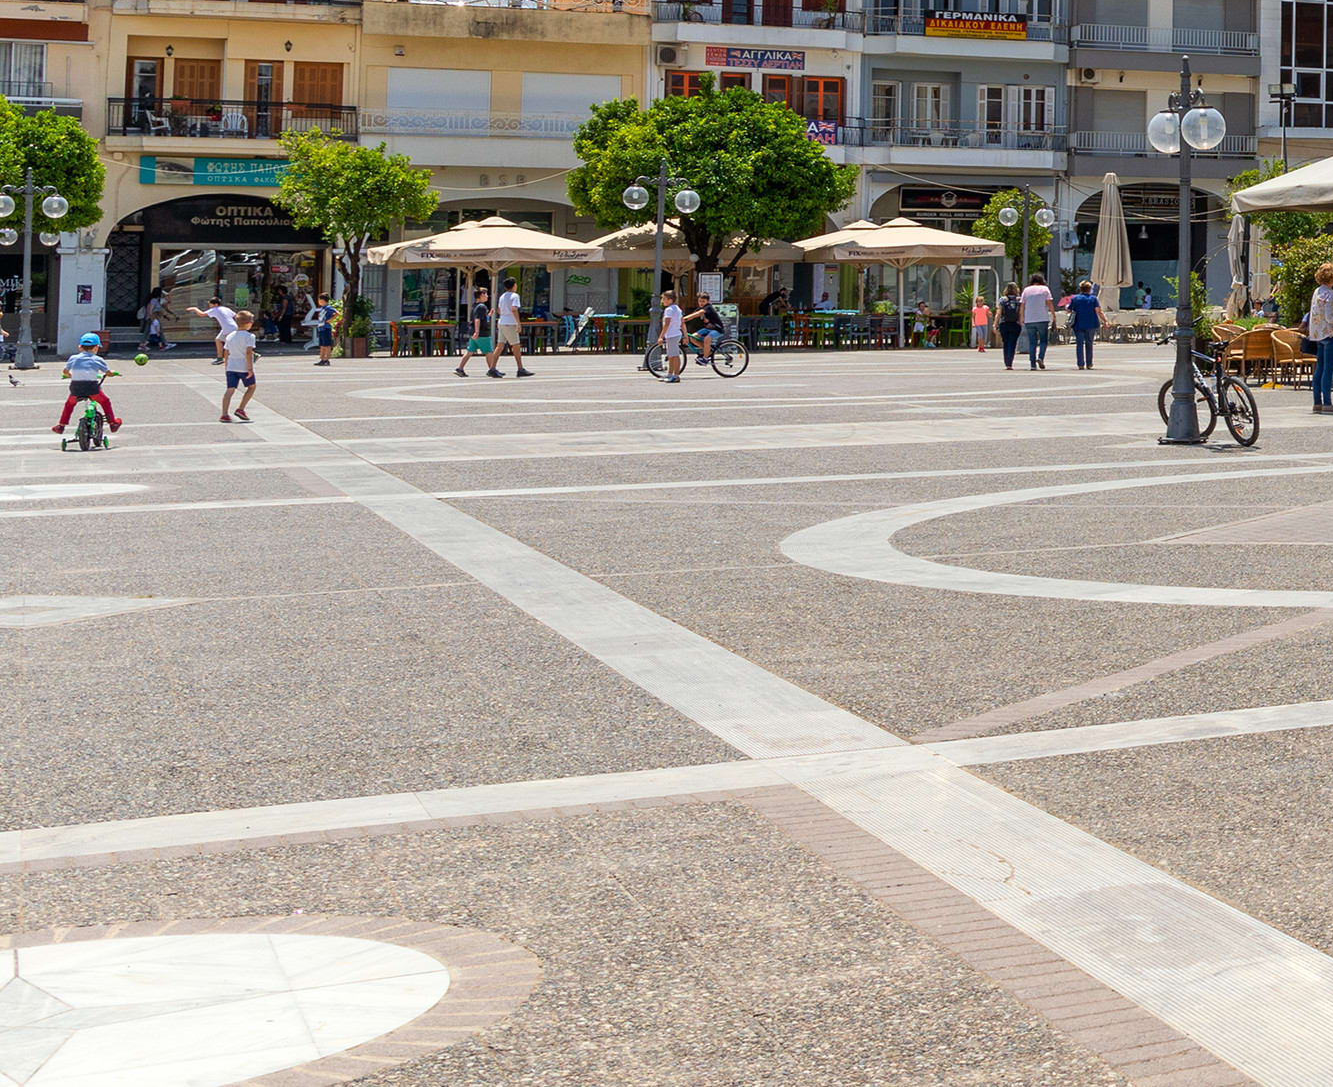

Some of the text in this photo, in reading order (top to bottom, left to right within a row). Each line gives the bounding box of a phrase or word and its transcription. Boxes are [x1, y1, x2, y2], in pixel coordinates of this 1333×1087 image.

[935, 11, 1017, 22] ΓΕΡΜΑΝΙΚΑ
[742, 50, 793, 61] ΑΓΓΛΙΚΑ
[215, 206, 274, 217] ΟΠΤΙΚΑ
[191, 216, 231, 227] Φώτης
